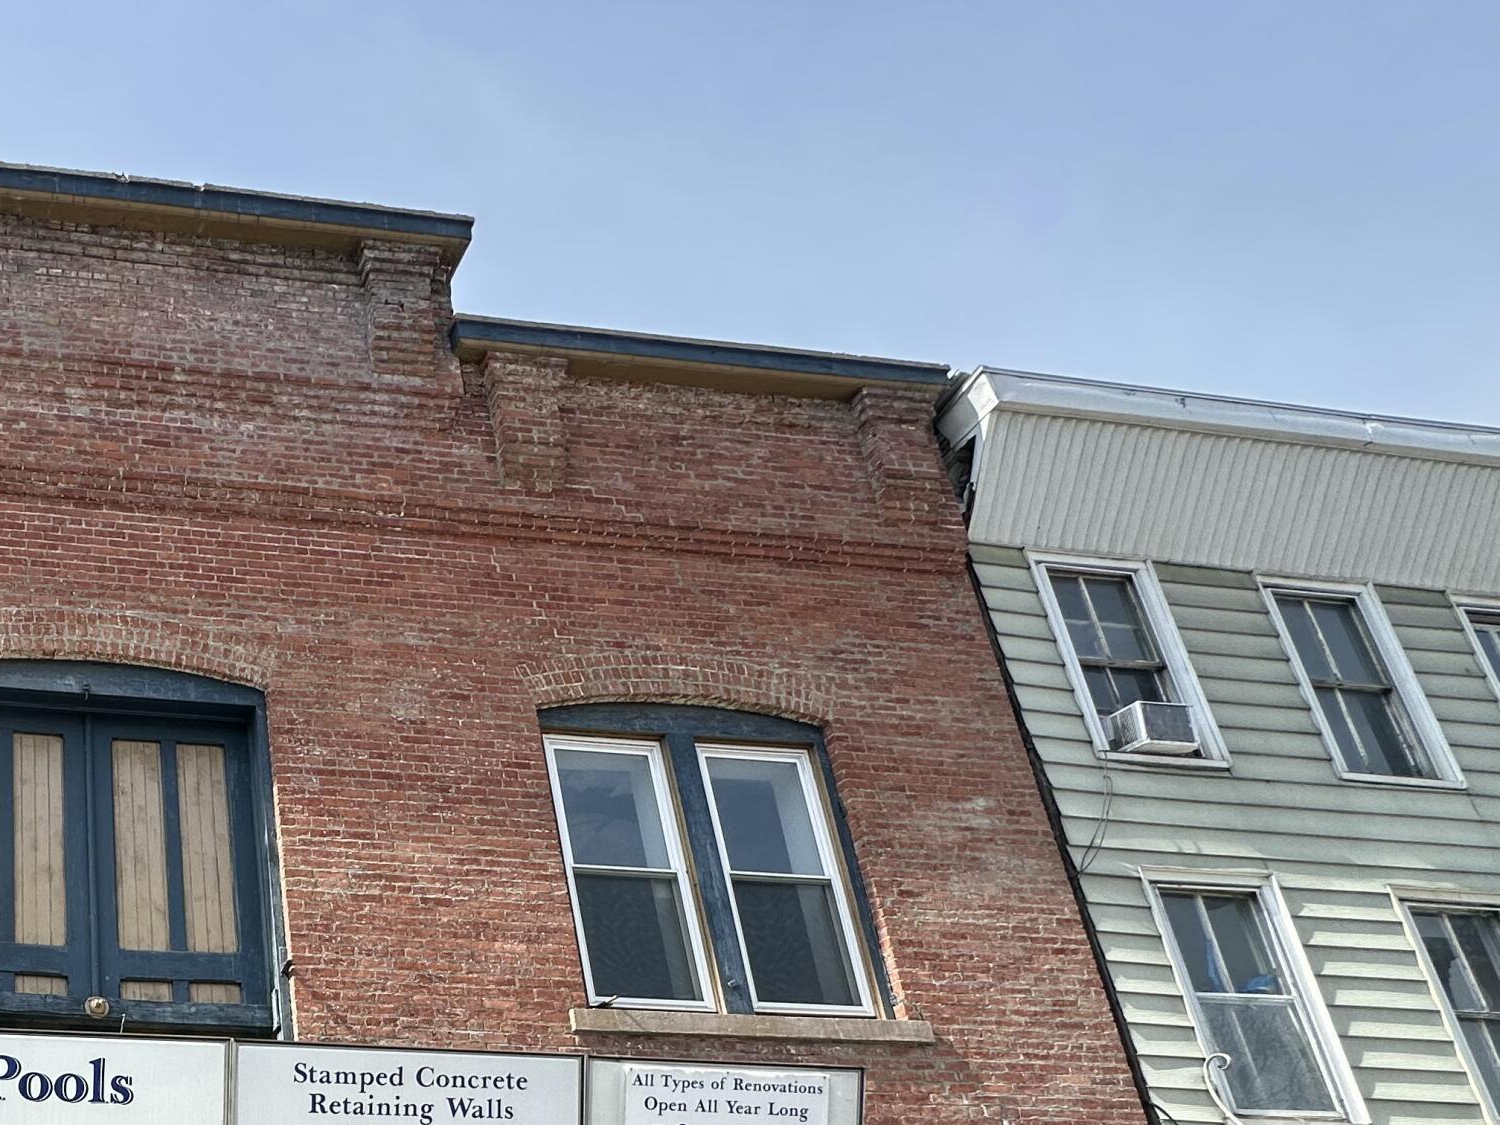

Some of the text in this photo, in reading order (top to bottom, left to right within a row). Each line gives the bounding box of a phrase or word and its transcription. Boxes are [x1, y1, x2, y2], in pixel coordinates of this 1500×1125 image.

[294, 1063, 527, 1093] Stamped Concrete
[633, 1074, 823, 1094] All Types of Renovations
[308, 1093, 513, 1125] Retaining Walls
[644, 1096, 808, 1122] Open All Year Long
